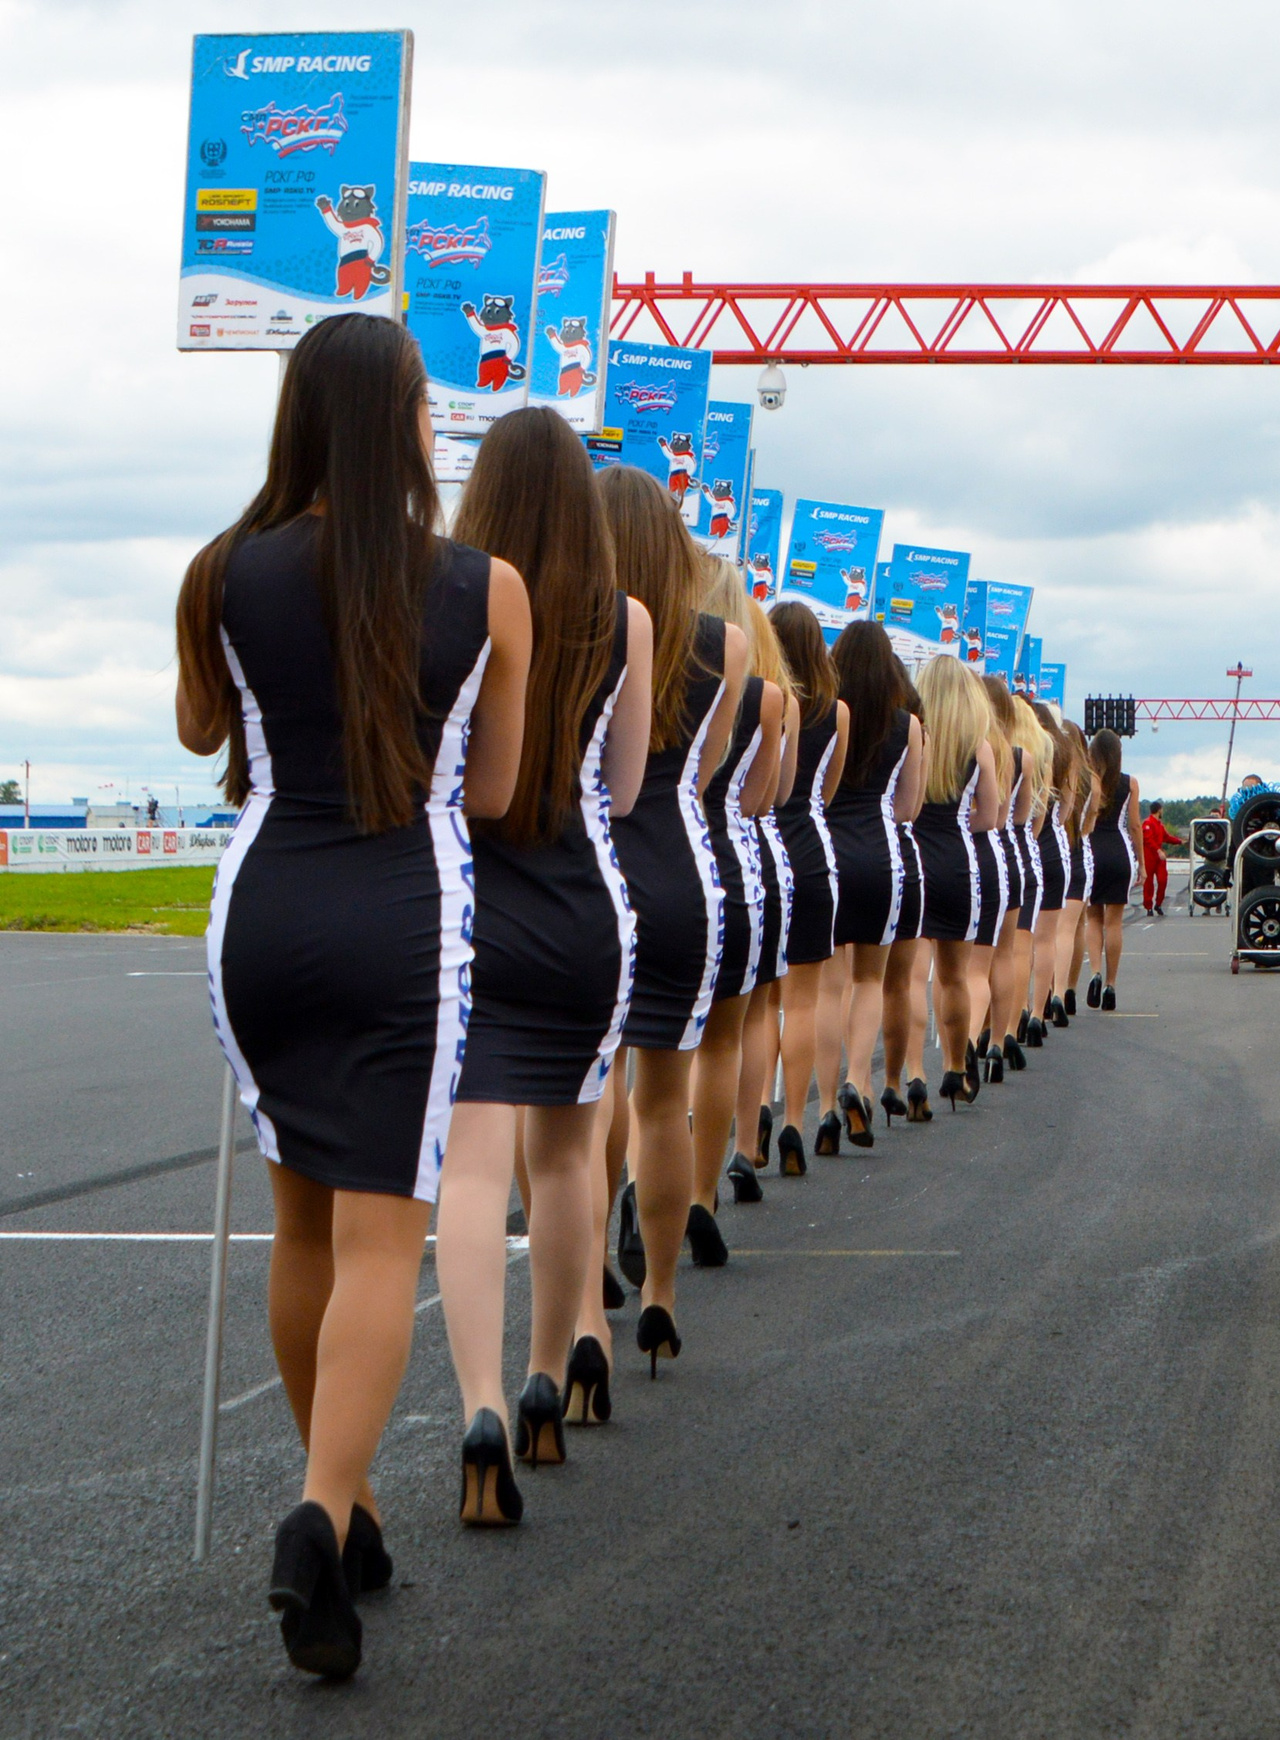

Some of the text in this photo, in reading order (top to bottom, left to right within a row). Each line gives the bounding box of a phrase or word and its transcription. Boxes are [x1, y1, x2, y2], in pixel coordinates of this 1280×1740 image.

[251, 55, 371, 73] SMP RACING
[265, 116, 329, 136] РСКГ
[264, 170, 315, 183] РСКГ.РФ
[408, 181, 514, 201] SMP RACING
[213, 218, 251, 226] YOKOHAMA
[542, 227, 585, 241] ACING
[418, 233, 475, 250] РСКГ
[416, 277, 462, 291] РСКГ.РФ
[621, 354, 692, 370] SMP RACING
[629, 388, 668, 401] РСКГ
[707, 411, 734, 423] CING
[819, 510, 870, 524] SMP RACING
[914, 553, 959, 566] SMP RACING
